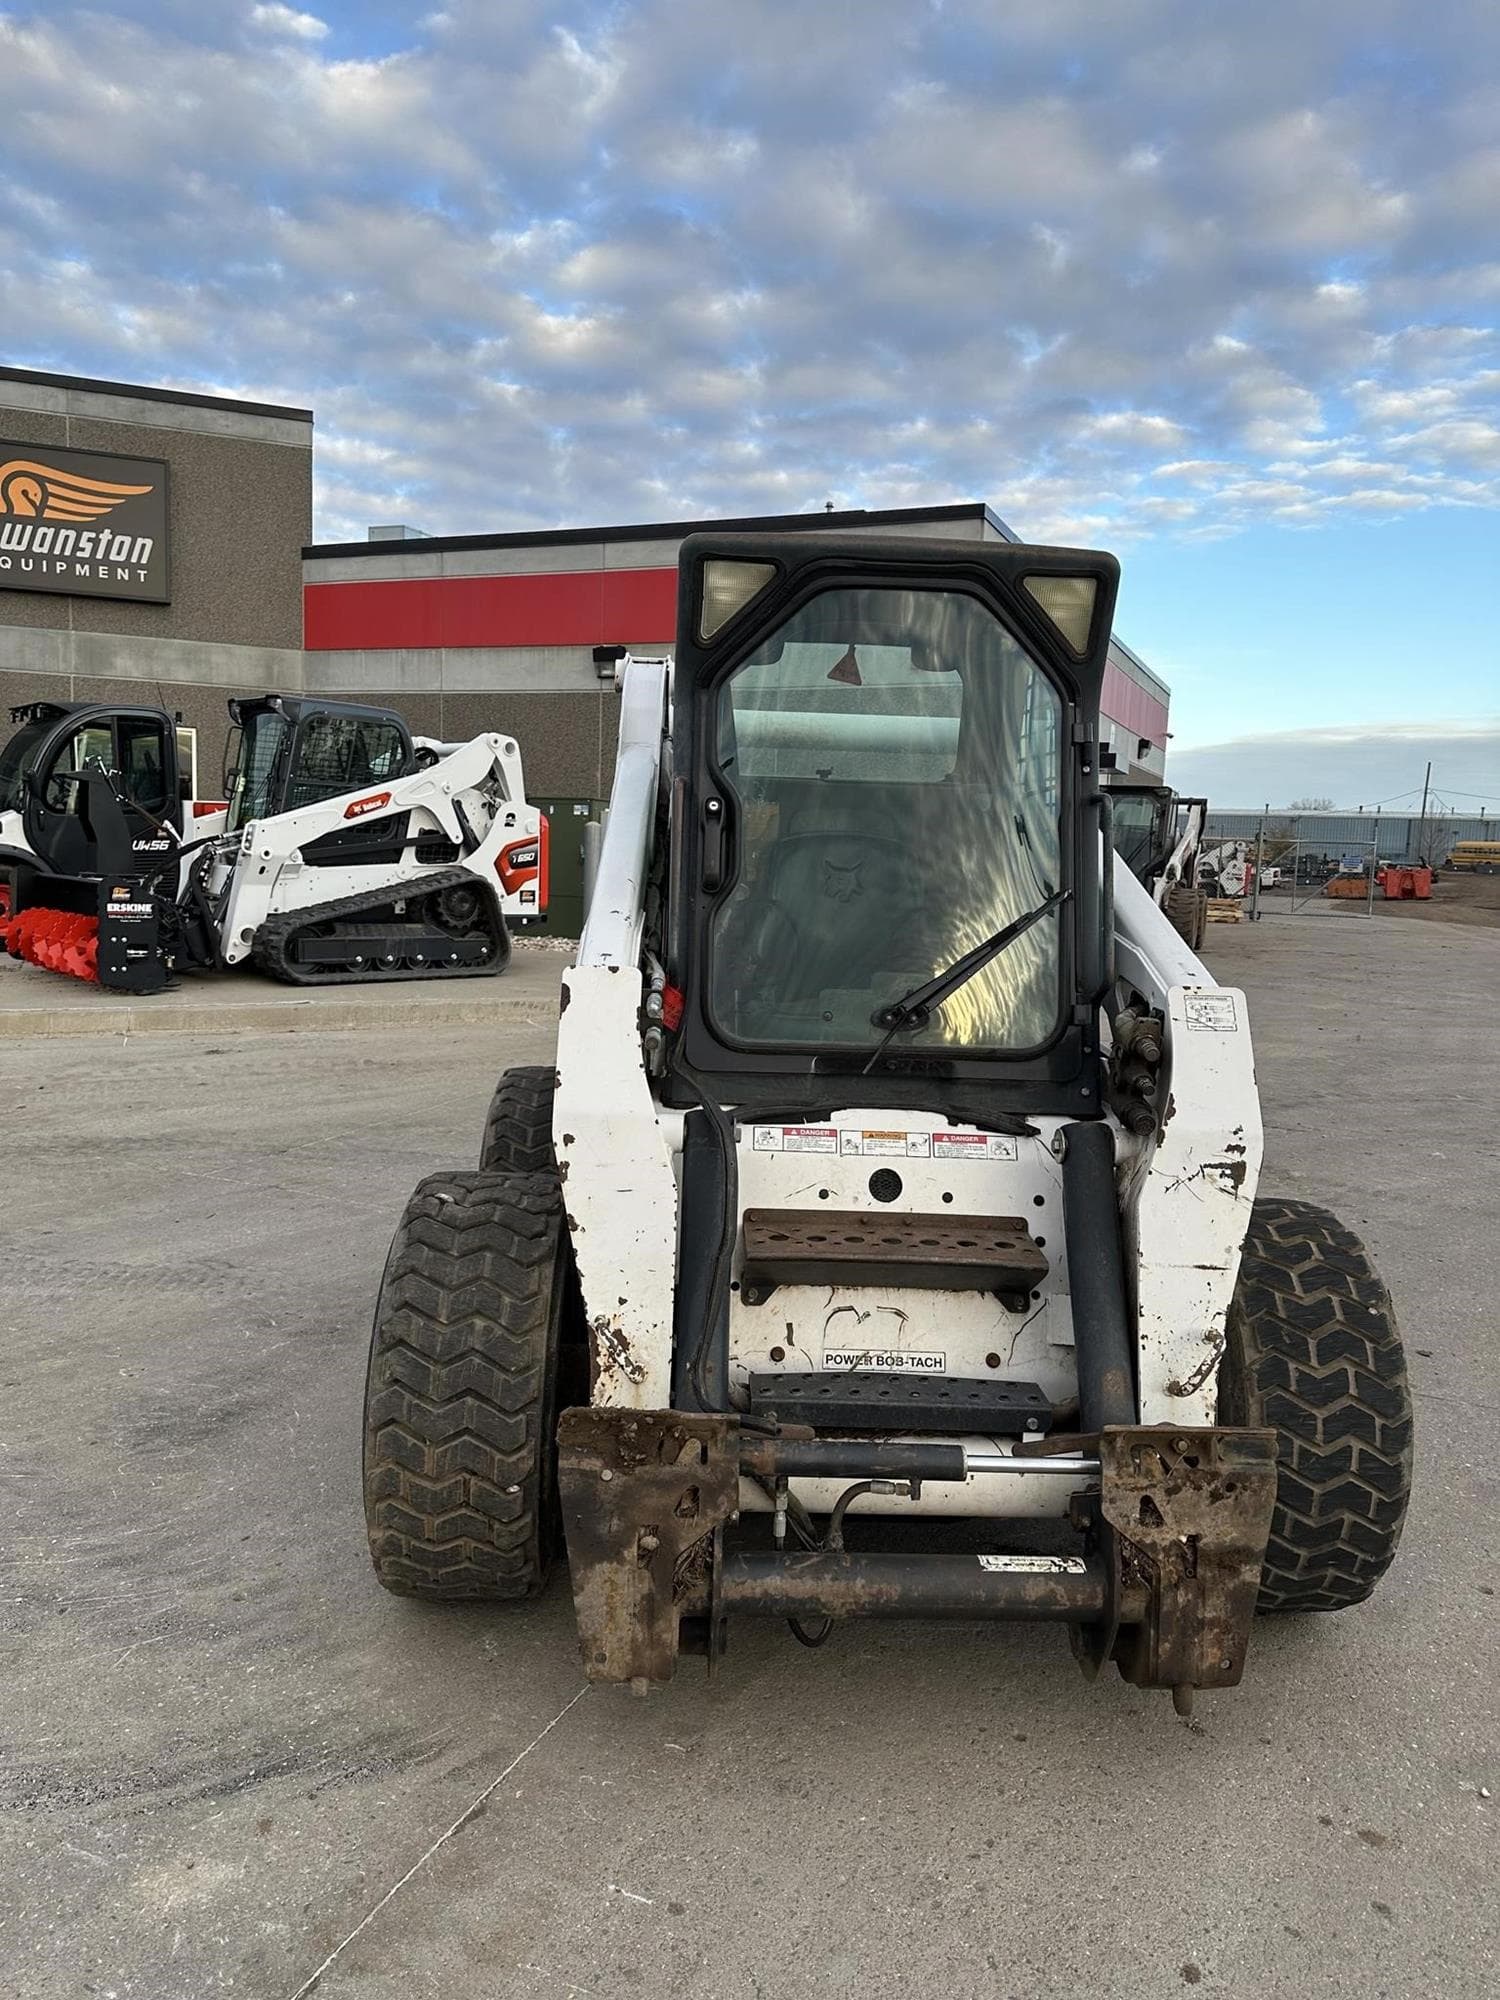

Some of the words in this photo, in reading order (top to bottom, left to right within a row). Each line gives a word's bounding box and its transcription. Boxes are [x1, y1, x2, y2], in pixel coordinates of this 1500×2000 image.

[0, 557, 148, 582] QUIPMENT
[132, 840, 170, 851] UW56
[107, 903, 153, 912] ERSKINE
[825, 1354, 873, 1366] POWER
[876, 1356, 943, 1368] BOB-TACH
